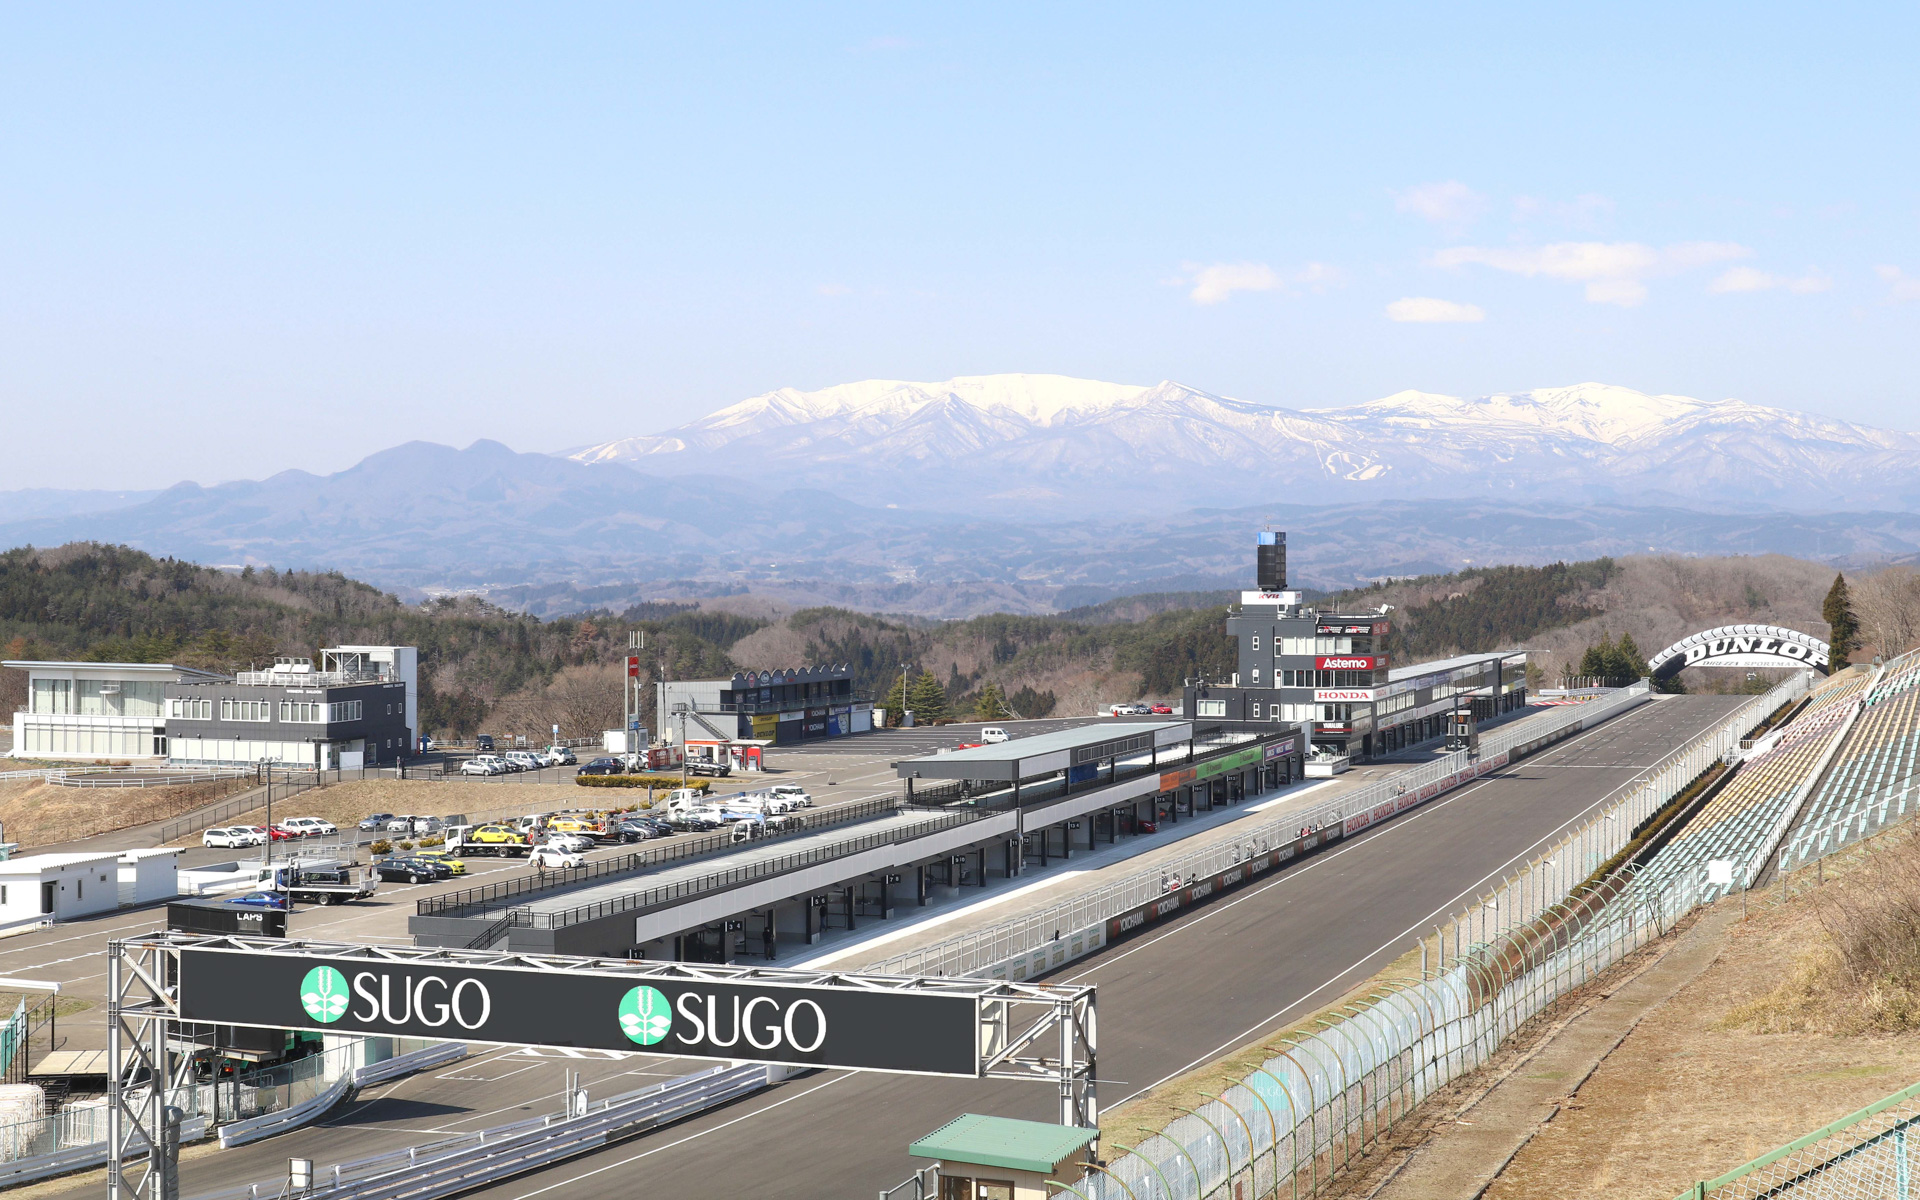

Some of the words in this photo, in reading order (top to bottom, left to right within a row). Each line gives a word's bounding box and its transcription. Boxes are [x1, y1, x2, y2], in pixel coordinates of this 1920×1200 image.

[1323, 657, 1368, 669] Astemo
[1684, 636, 1830, 667] DUNLOP
[1318, 691, 1370, 700] HONDA
[757, 729, 775, 738] DUNLOP
[1346, 812, 1370, 833] HONDA
[1373, 801, 1396, 821] HONDA
[1397, 791, 1418, 810] HONDA
[1419, 783, 1439, 801] HONDA
[1440, 775, 1458, 792] HONDA
[1459, 767, 1476, 783] HONDA
[1477, 759, 1492, 775] HONDA
[1493, 752, 1508, 768] HONDA
[1120, 911, 1145, 932] YOKOHAMA
[1157, 896, 1180, 916] YOKOHAMA
[1191, 882, 1212, 900] YOKOHAMA
[1223, 869, 1242, 887] YOKOHAMA
[1251, 857, 1270, 874] YOKOHAMA
[1278, 846, 1295, 862] YOKOHAMA
[236, 912, 263, 922] LAPS
[353, 971, 491, 1030] SUGO
[676, 992, 827, 1052] SUGO
